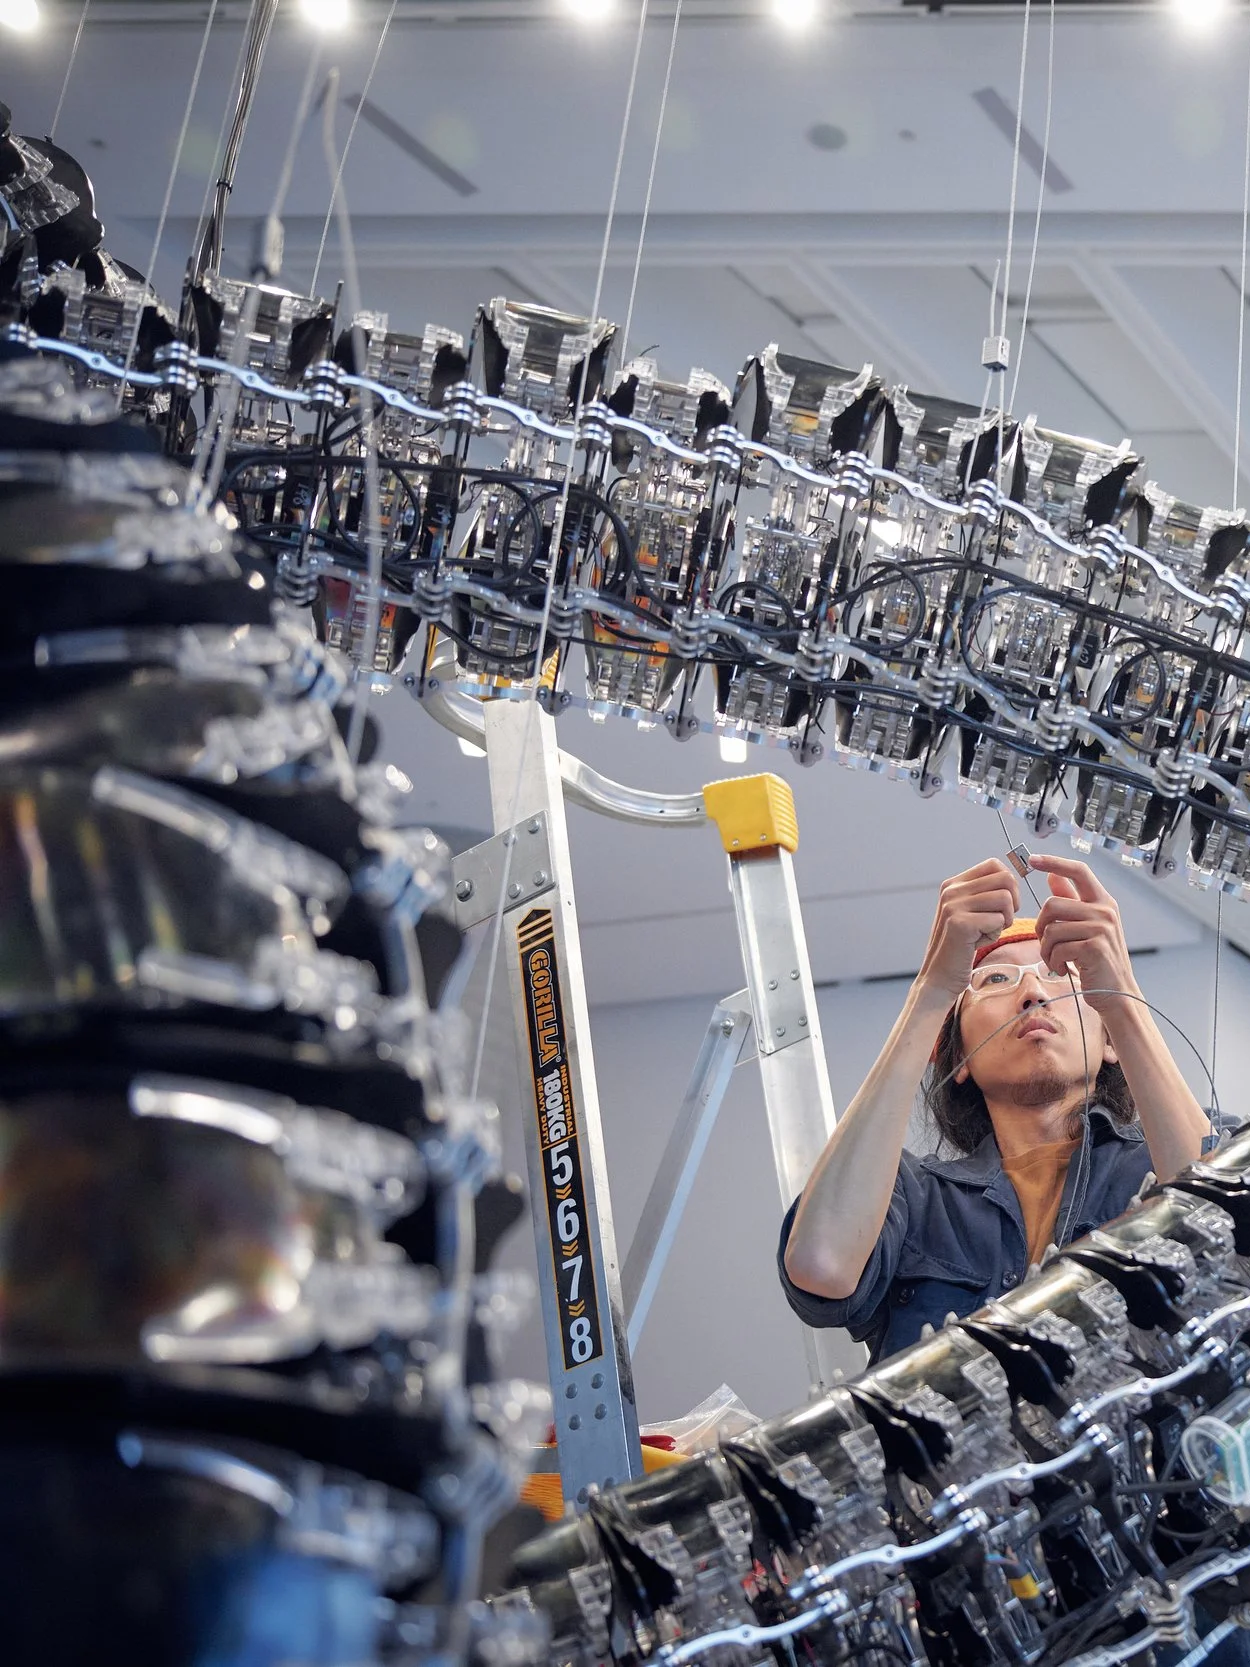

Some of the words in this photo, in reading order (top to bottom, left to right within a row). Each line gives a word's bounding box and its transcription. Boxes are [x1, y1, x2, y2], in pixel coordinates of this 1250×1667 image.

[528, 948, 561, 1068] GORILLA
[536, 1077, 546, 1112] HEAVY
[543, 1068, 568, 1143] 180KG
[560, 1064, 575, 1136] INDUSTRIAL
[540, 1114, 550, 1145] DUTY
[549, 1142, 574, 1187] 5
[557, 1197, 580, 1243] 6
[562, 1255, 582, 1302] 7
[569, 1316, 594, 1363] 8
